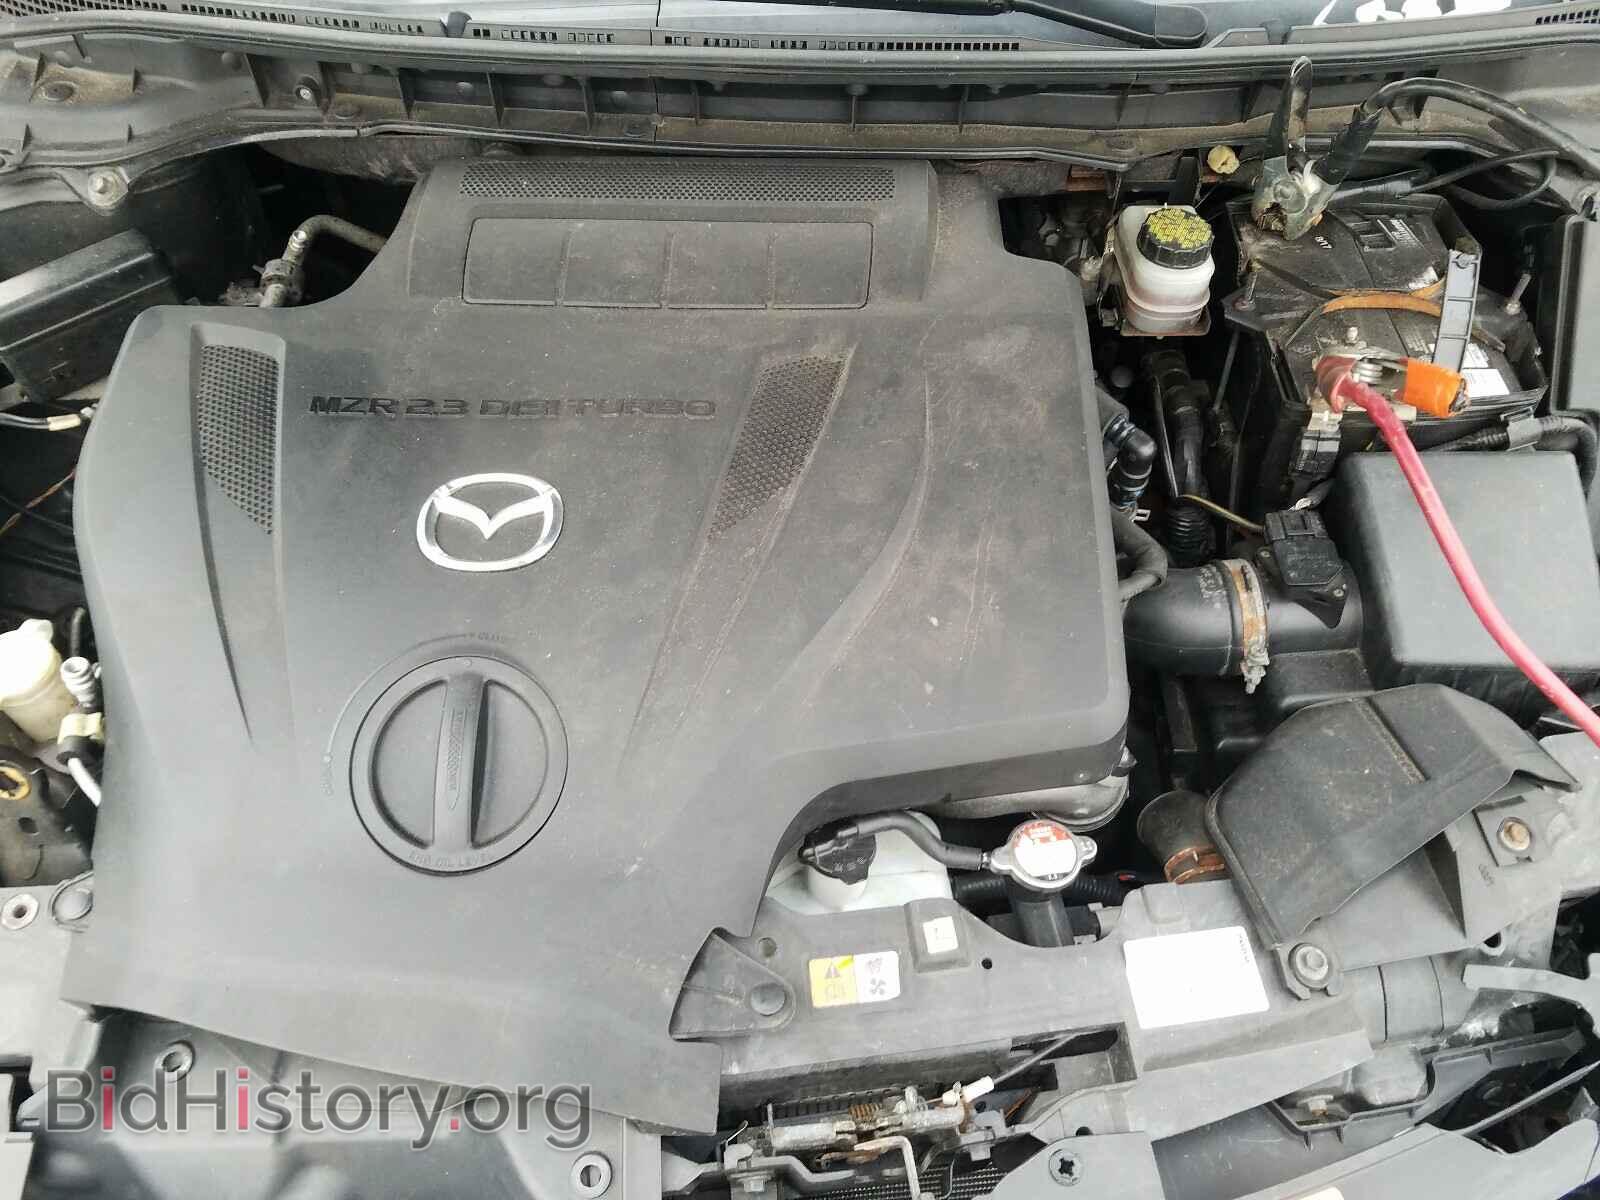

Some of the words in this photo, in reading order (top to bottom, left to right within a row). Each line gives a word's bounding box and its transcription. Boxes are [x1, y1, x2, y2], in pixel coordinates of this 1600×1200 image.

[308, 395, 396, 416] MZR
[405, 397, 470, 417] 2.3
[568, 399, 716, 420] TURBO
